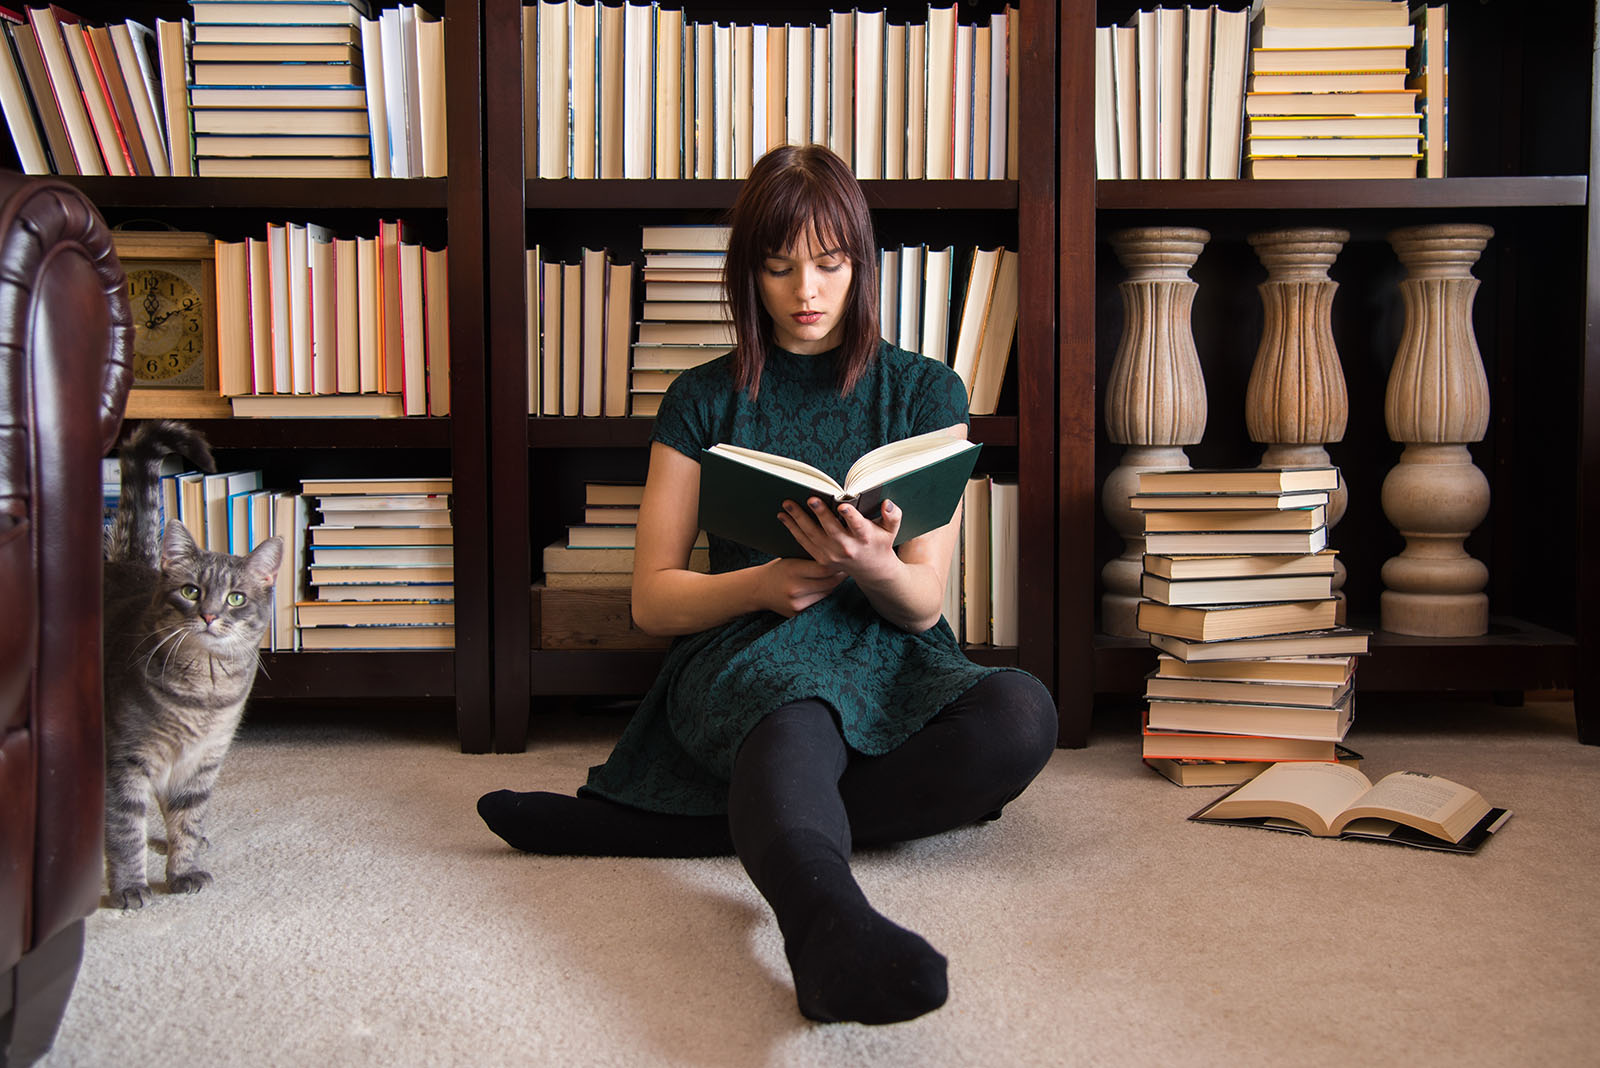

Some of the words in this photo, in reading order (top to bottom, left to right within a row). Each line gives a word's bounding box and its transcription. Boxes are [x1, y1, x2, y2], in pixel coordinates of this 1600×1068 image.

[131, 282, 135, 296] 1
[144, 277, 159, 290] 12
[182, 298, 193, 311] 2
[189, 319, 198, 332] 3
[183, 340, 194, 352] 4
[147, 360, 157, 372] 6
[169, 354, 178, 367] 5
